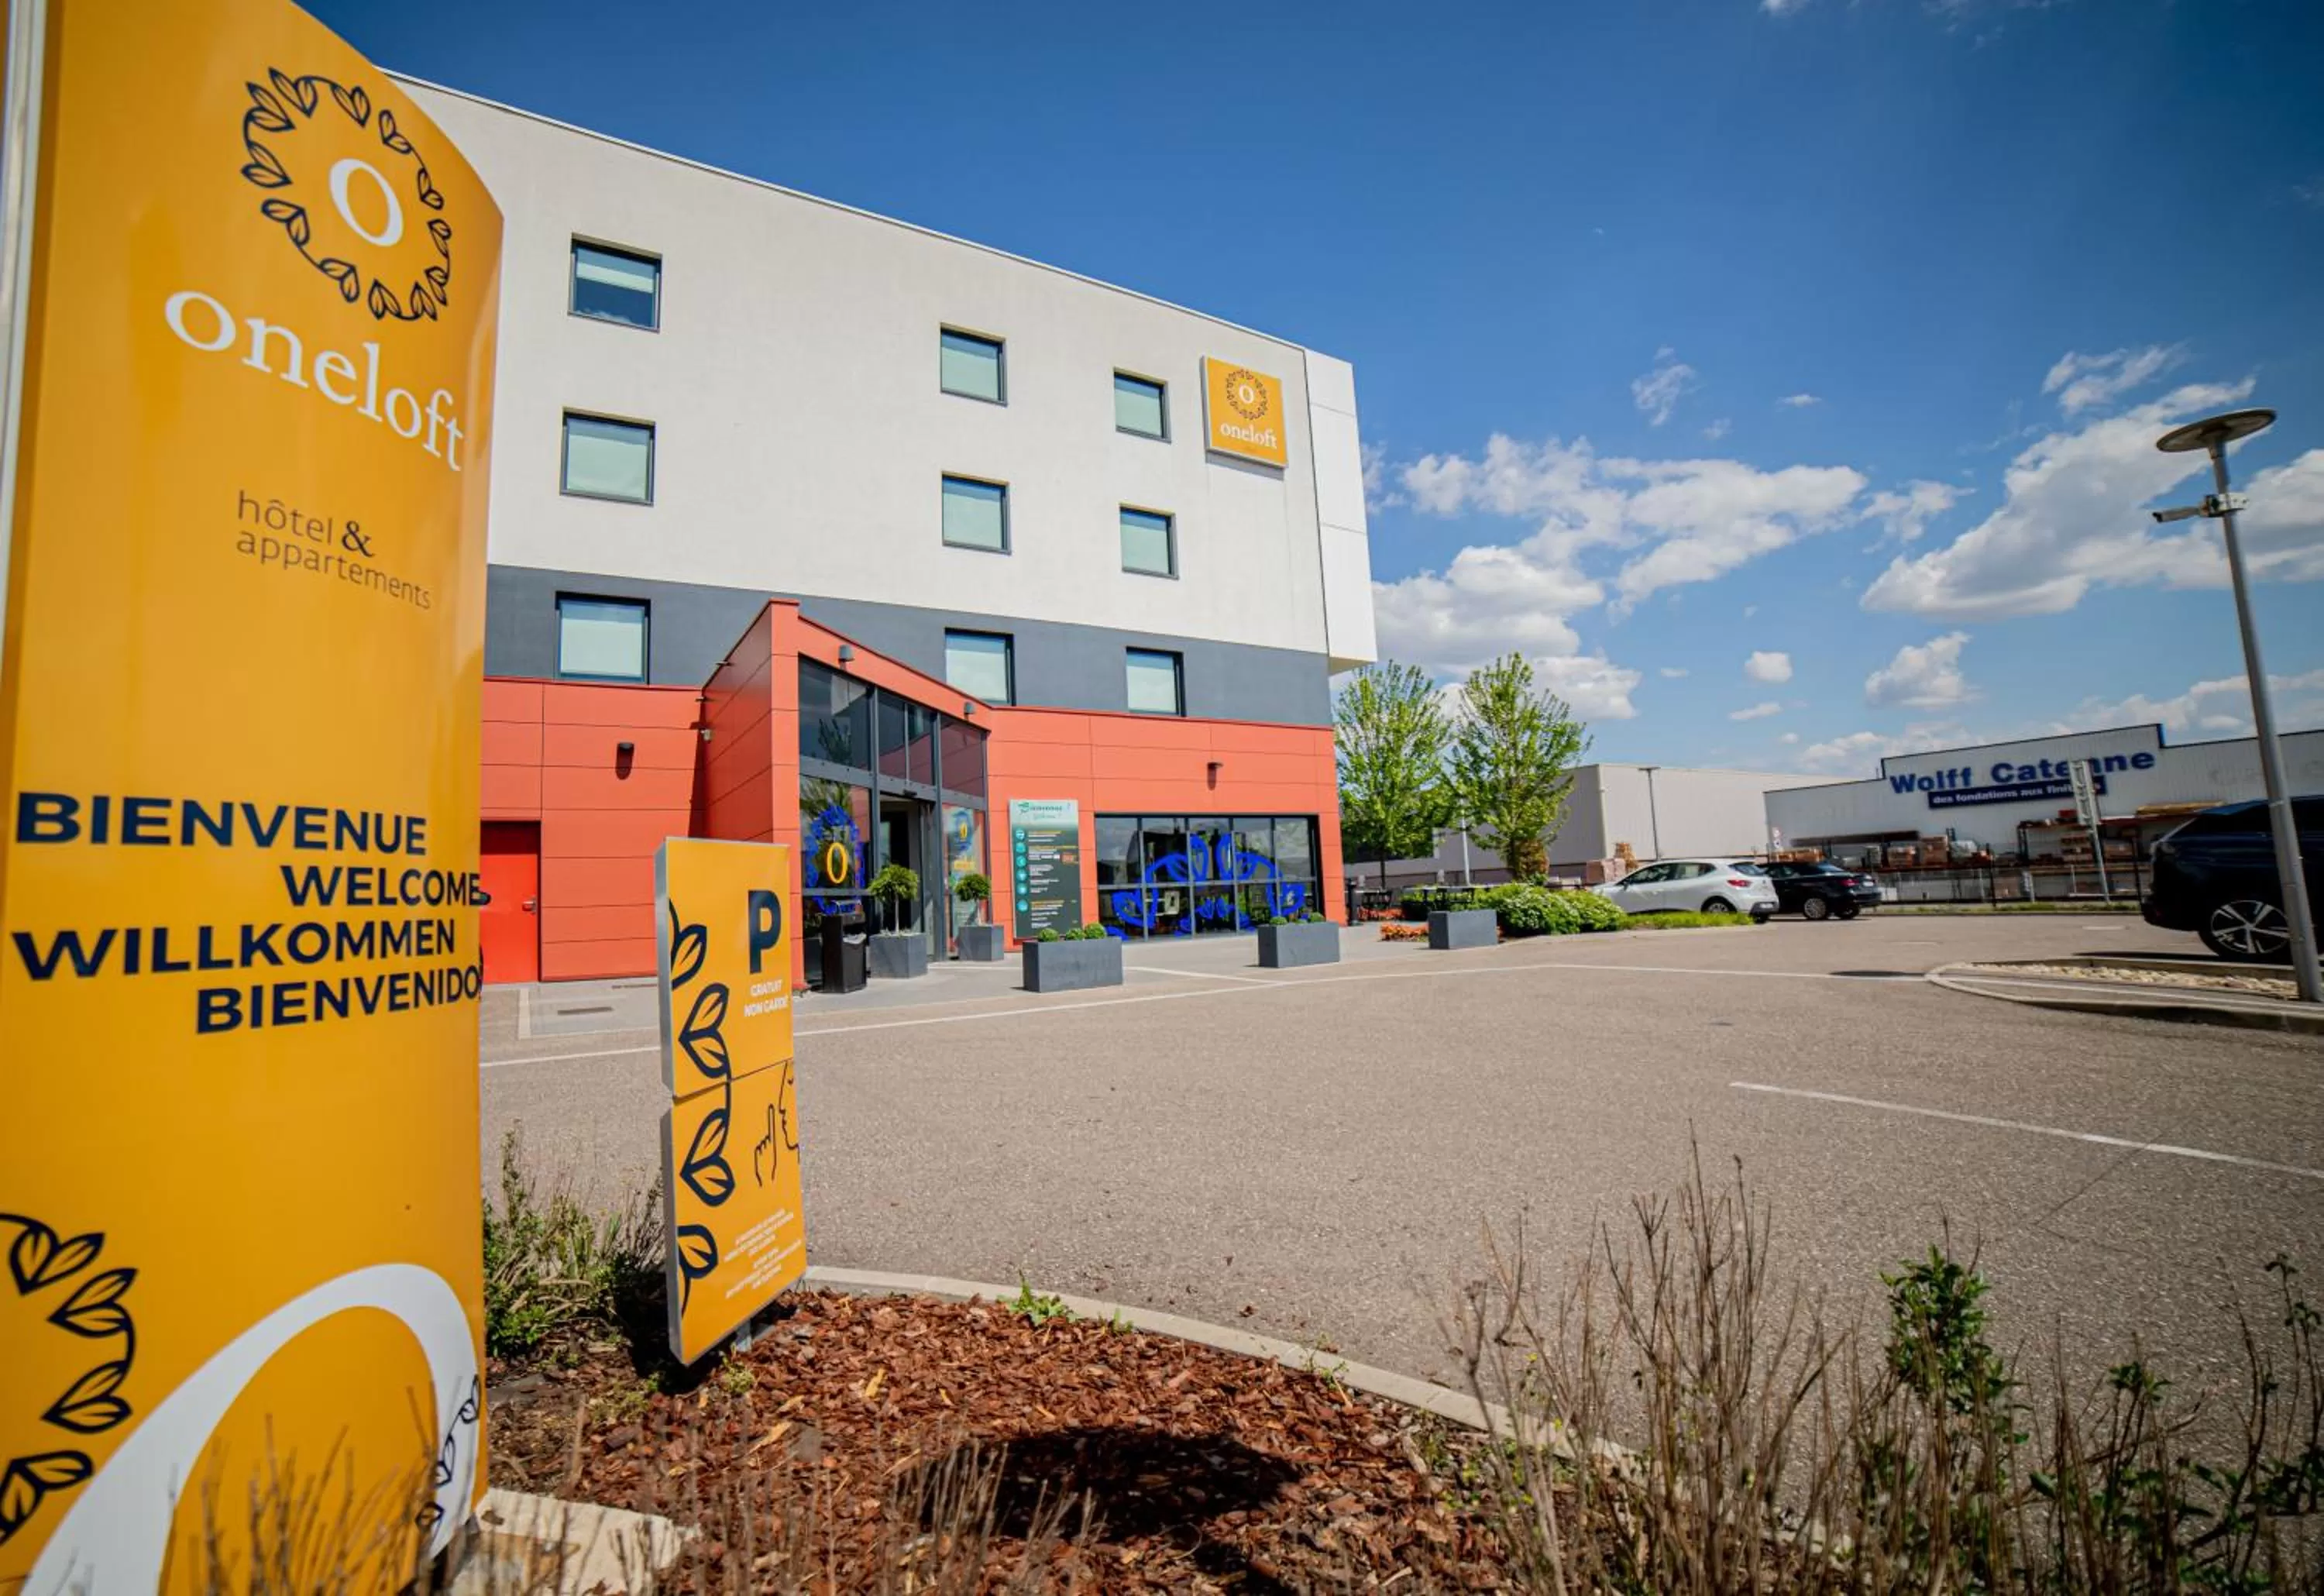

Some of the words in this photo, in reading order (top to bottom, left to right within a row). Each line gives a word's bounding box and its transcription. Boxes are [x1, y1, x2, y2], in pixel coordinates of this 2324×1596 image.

[165, 291, 464, 471] oneloft
[1220, 423, 1277, 449] oneloft
[239, 490, 334, 544] hôtel
[342, 521, 376, 557] &
[236, 528, 431, 610] appartements
[1889, 767, 1972, 793] Wolff
[1933, 796, 1953, 804] des
[1956, 790, 2018, 802] fondations
[2020, 788, 2044, 797] aux
[15, 791, 426, 855] BIENVENUE
[280, 865, 480, 906] WELCOME
[13, 918, 455, 981] WILLKOMMEN
[748, 889, 782, 975] P
[195, 965, 480, 1034] BIENVENIDO
